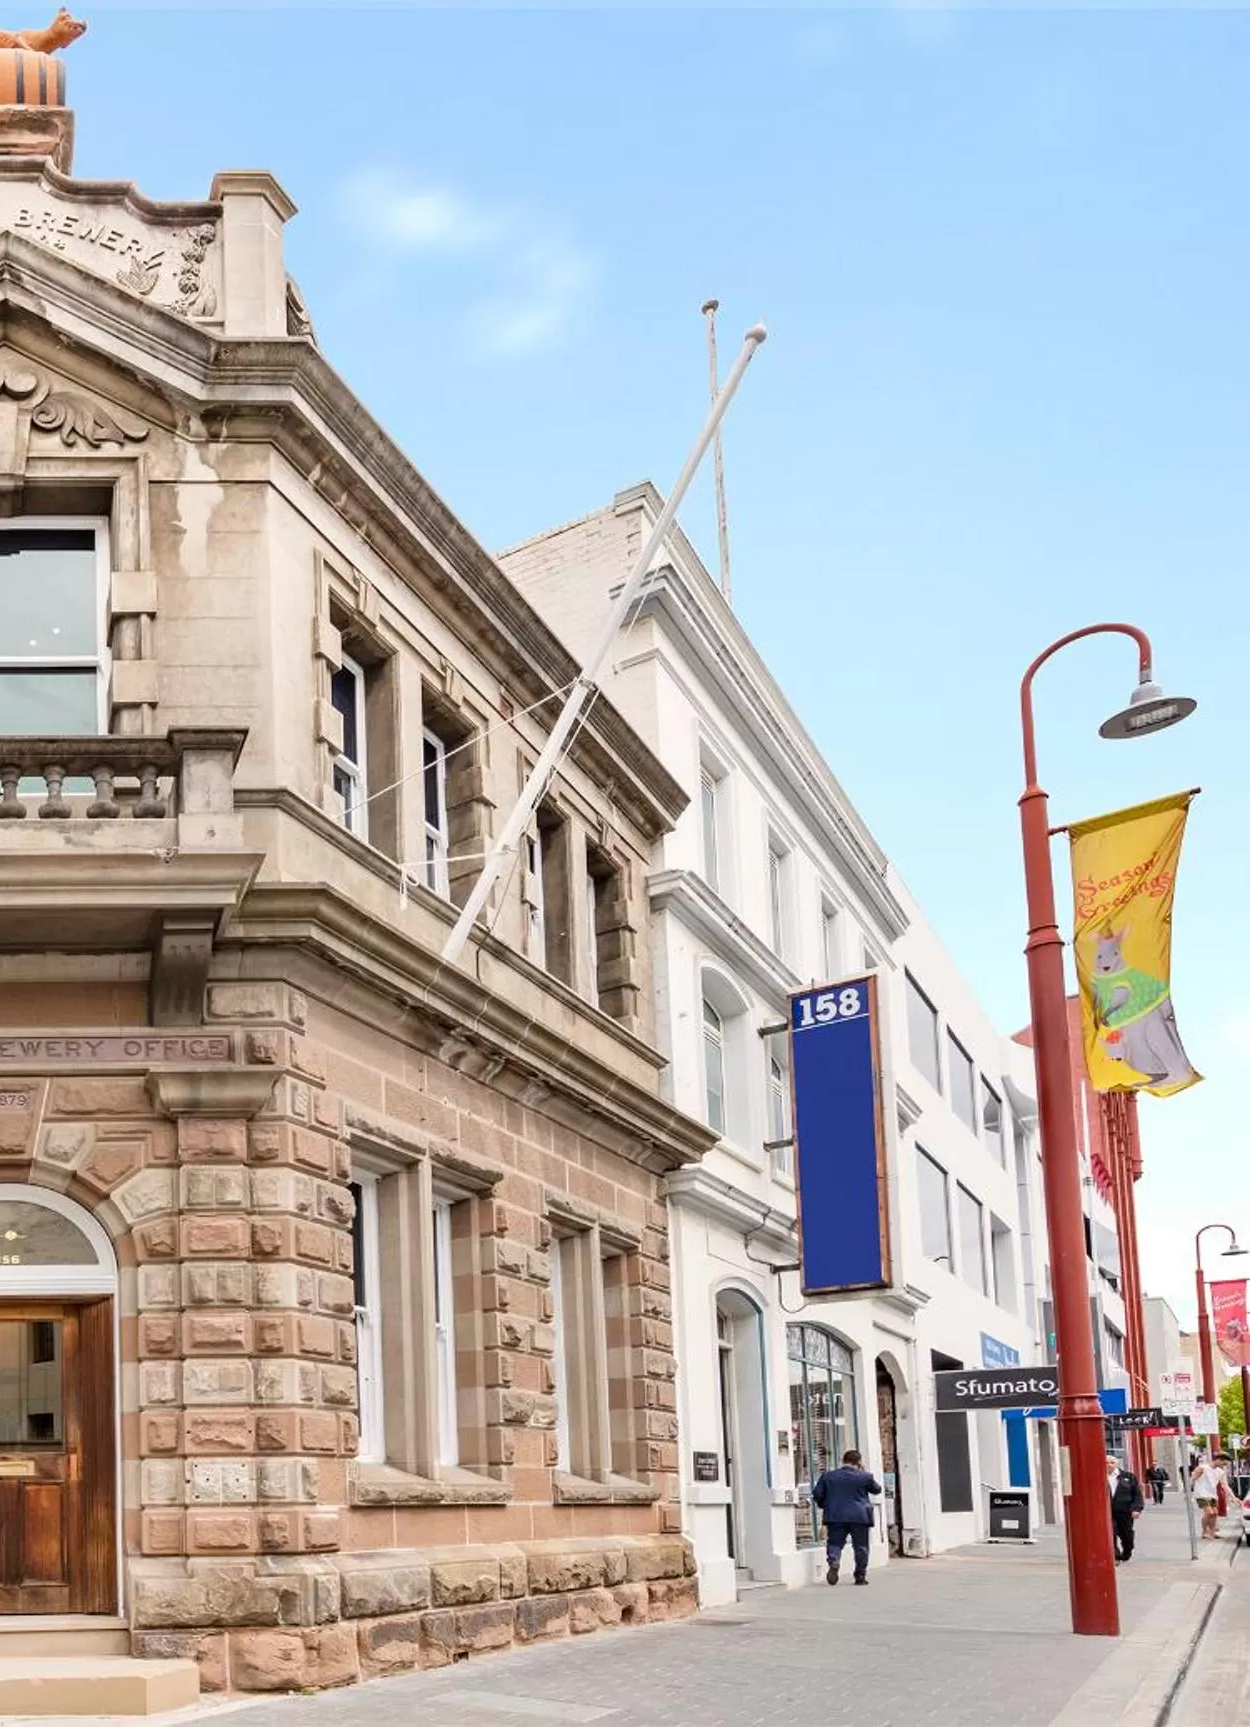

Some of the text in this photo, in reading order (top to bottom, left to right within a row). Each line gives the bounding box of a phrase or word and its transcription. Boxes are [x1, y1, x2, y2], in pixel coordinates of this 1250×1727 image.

[13, 206, 167, 267] BREWERY
[799, 988, 861, 1026] 158
[123, 1039, 226, 1058] OFFICE
[955, 1378, 1056, 1397] Sfumato
